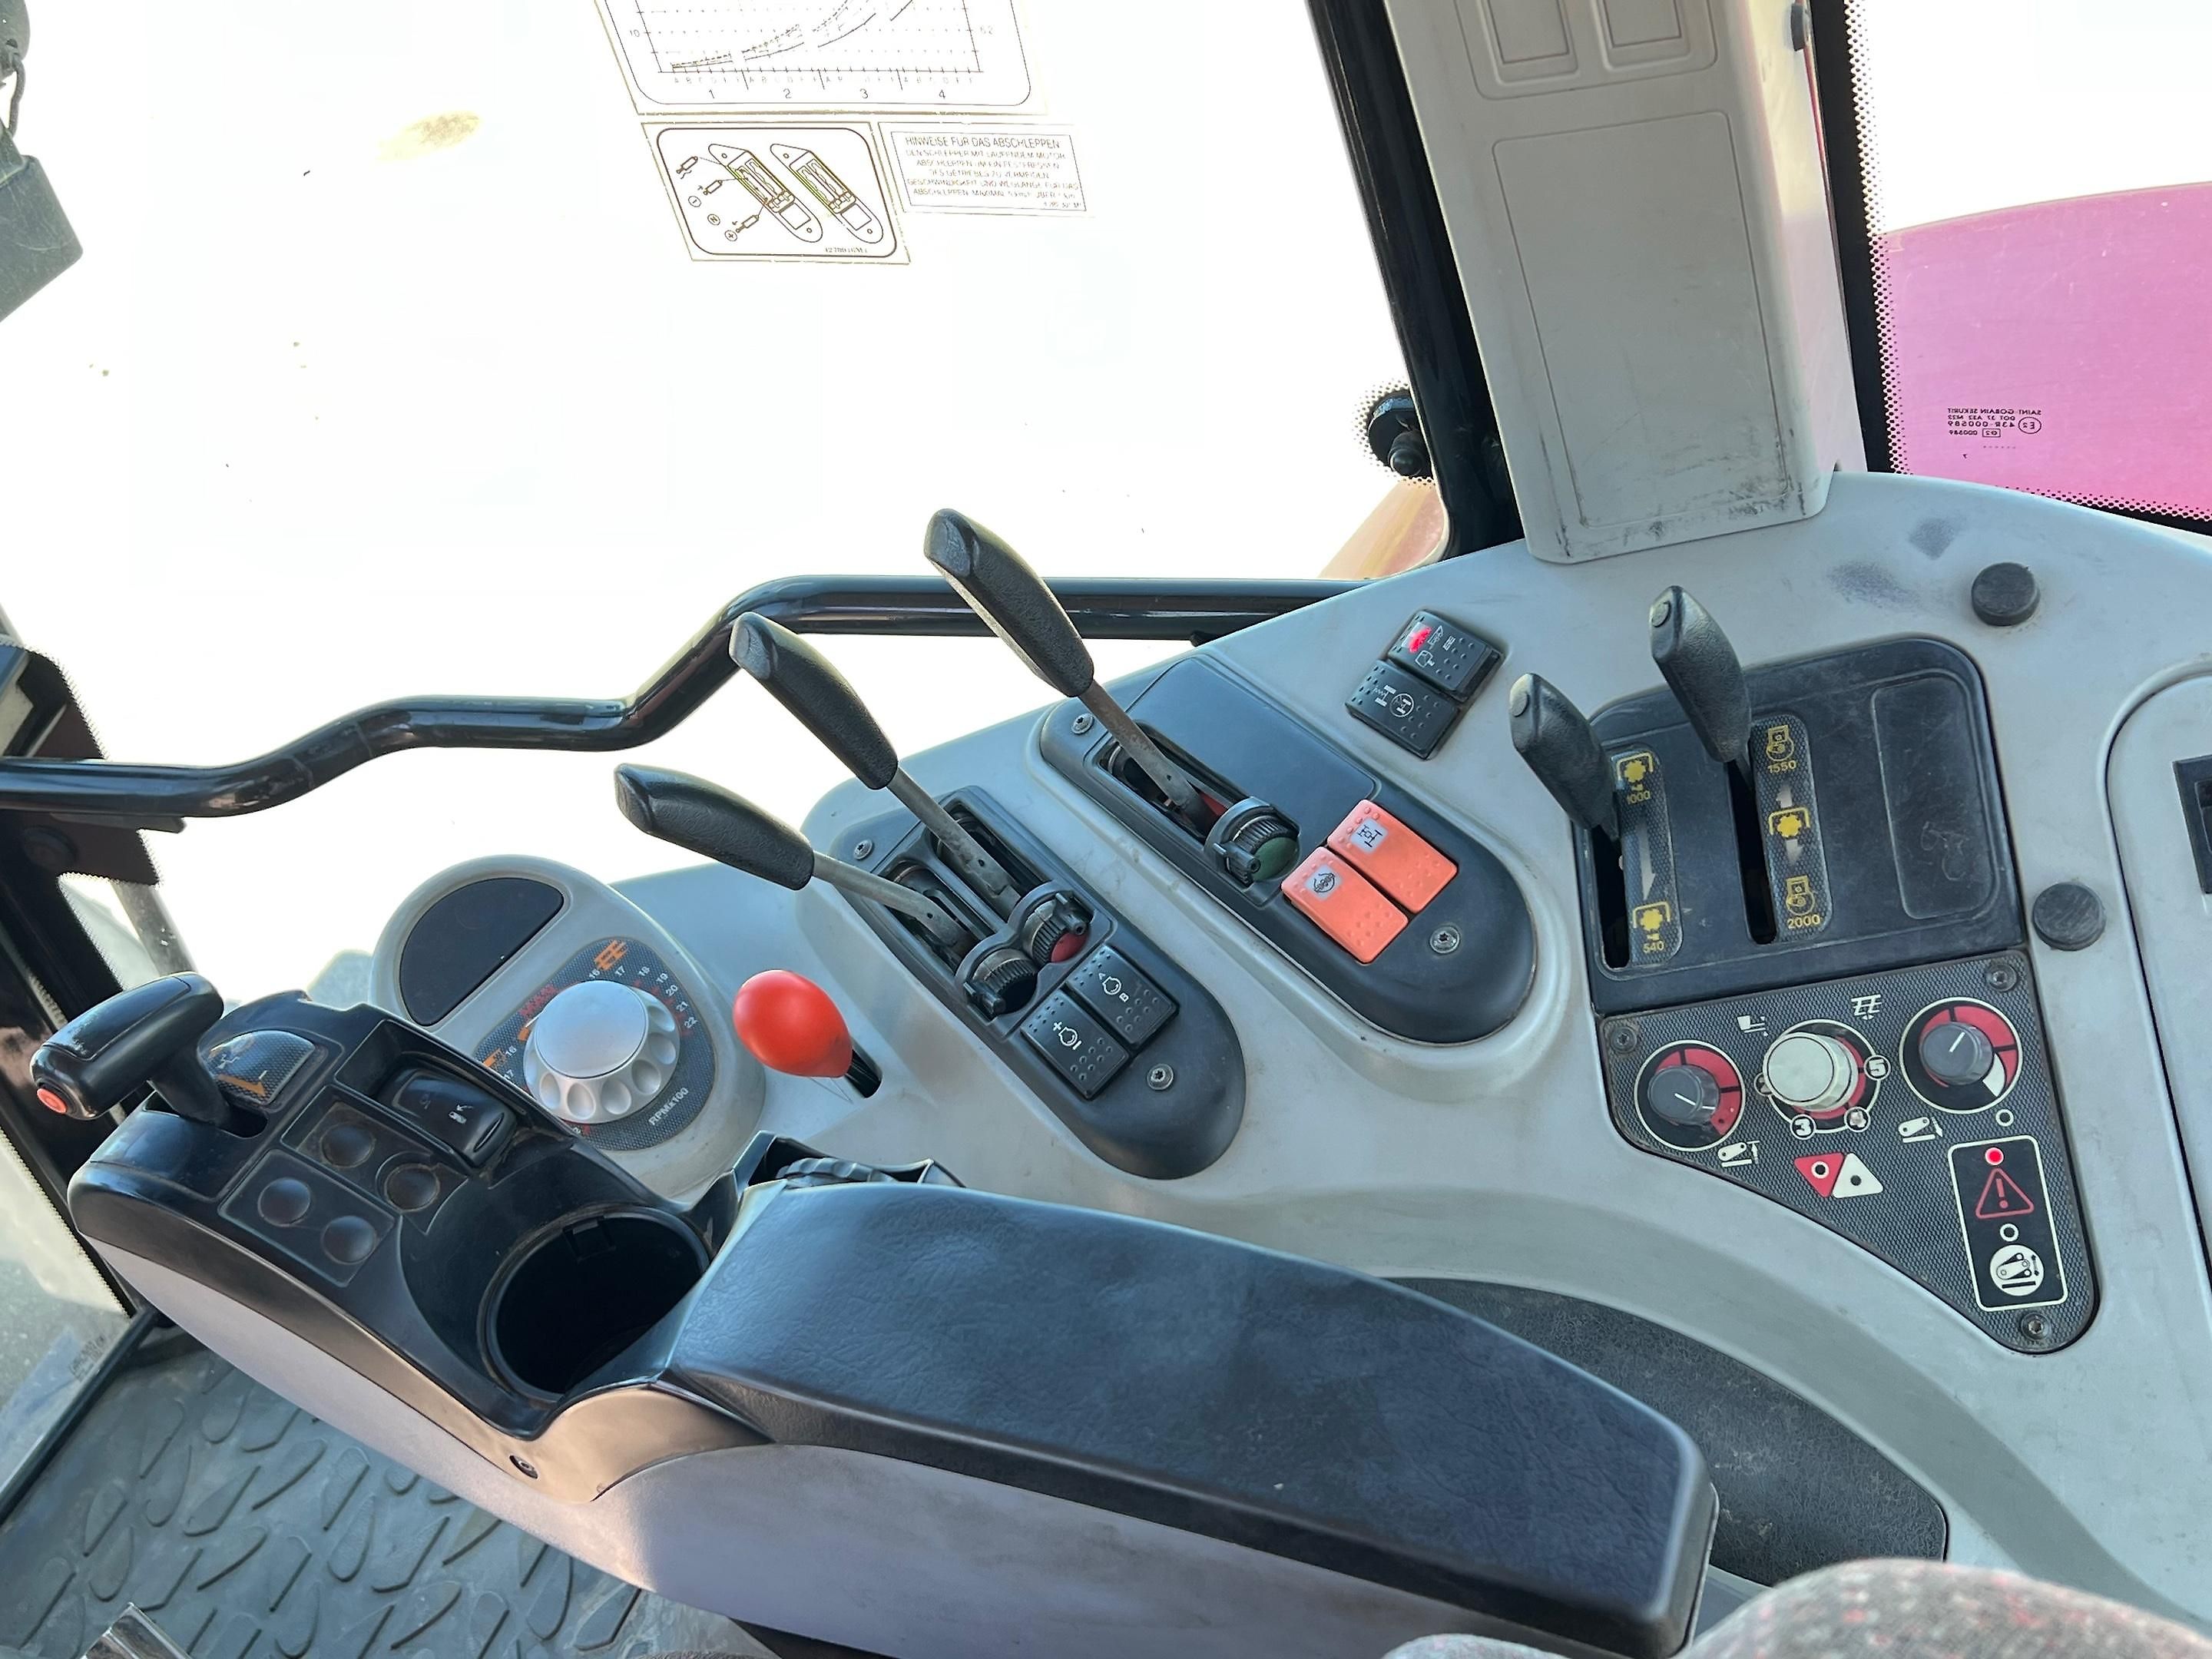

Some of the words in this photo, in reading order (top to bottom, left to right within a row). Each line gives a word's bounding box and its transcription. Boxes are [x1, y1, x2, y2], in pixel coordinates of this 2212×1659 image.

[629, 28, 641, 38] 10
[708, 89, 715, 99] 1
[783, 88, 793, 99] 2
[859, 88, 869, 99] 3
[939, 89, 946, 99] 4
[905, 137, 949, 147] HINWEISE
[971, 137, 992, 147] DAS
[992, 137, 1061, 149] ABSCHLEPPEN
[1767, 759, 1797, 774] 1550
[1626, 790, 1651, 805] 1000
[1786, 913, 1820, 929] 2000
[1643, 939, 1665, 954] 540
[614, 965, 625, 977] 17
[637, 966, 650, 977] 18
[656, 972, 668, 983] 19
[665, 985, 678, 997] 20
[676, 1001, 688, 1012] 21
[684, 1017, 699, 1029] 22
[1868, 1058, 1886, 1077] 5
[1794, 1118, 1812, 1137] 3
